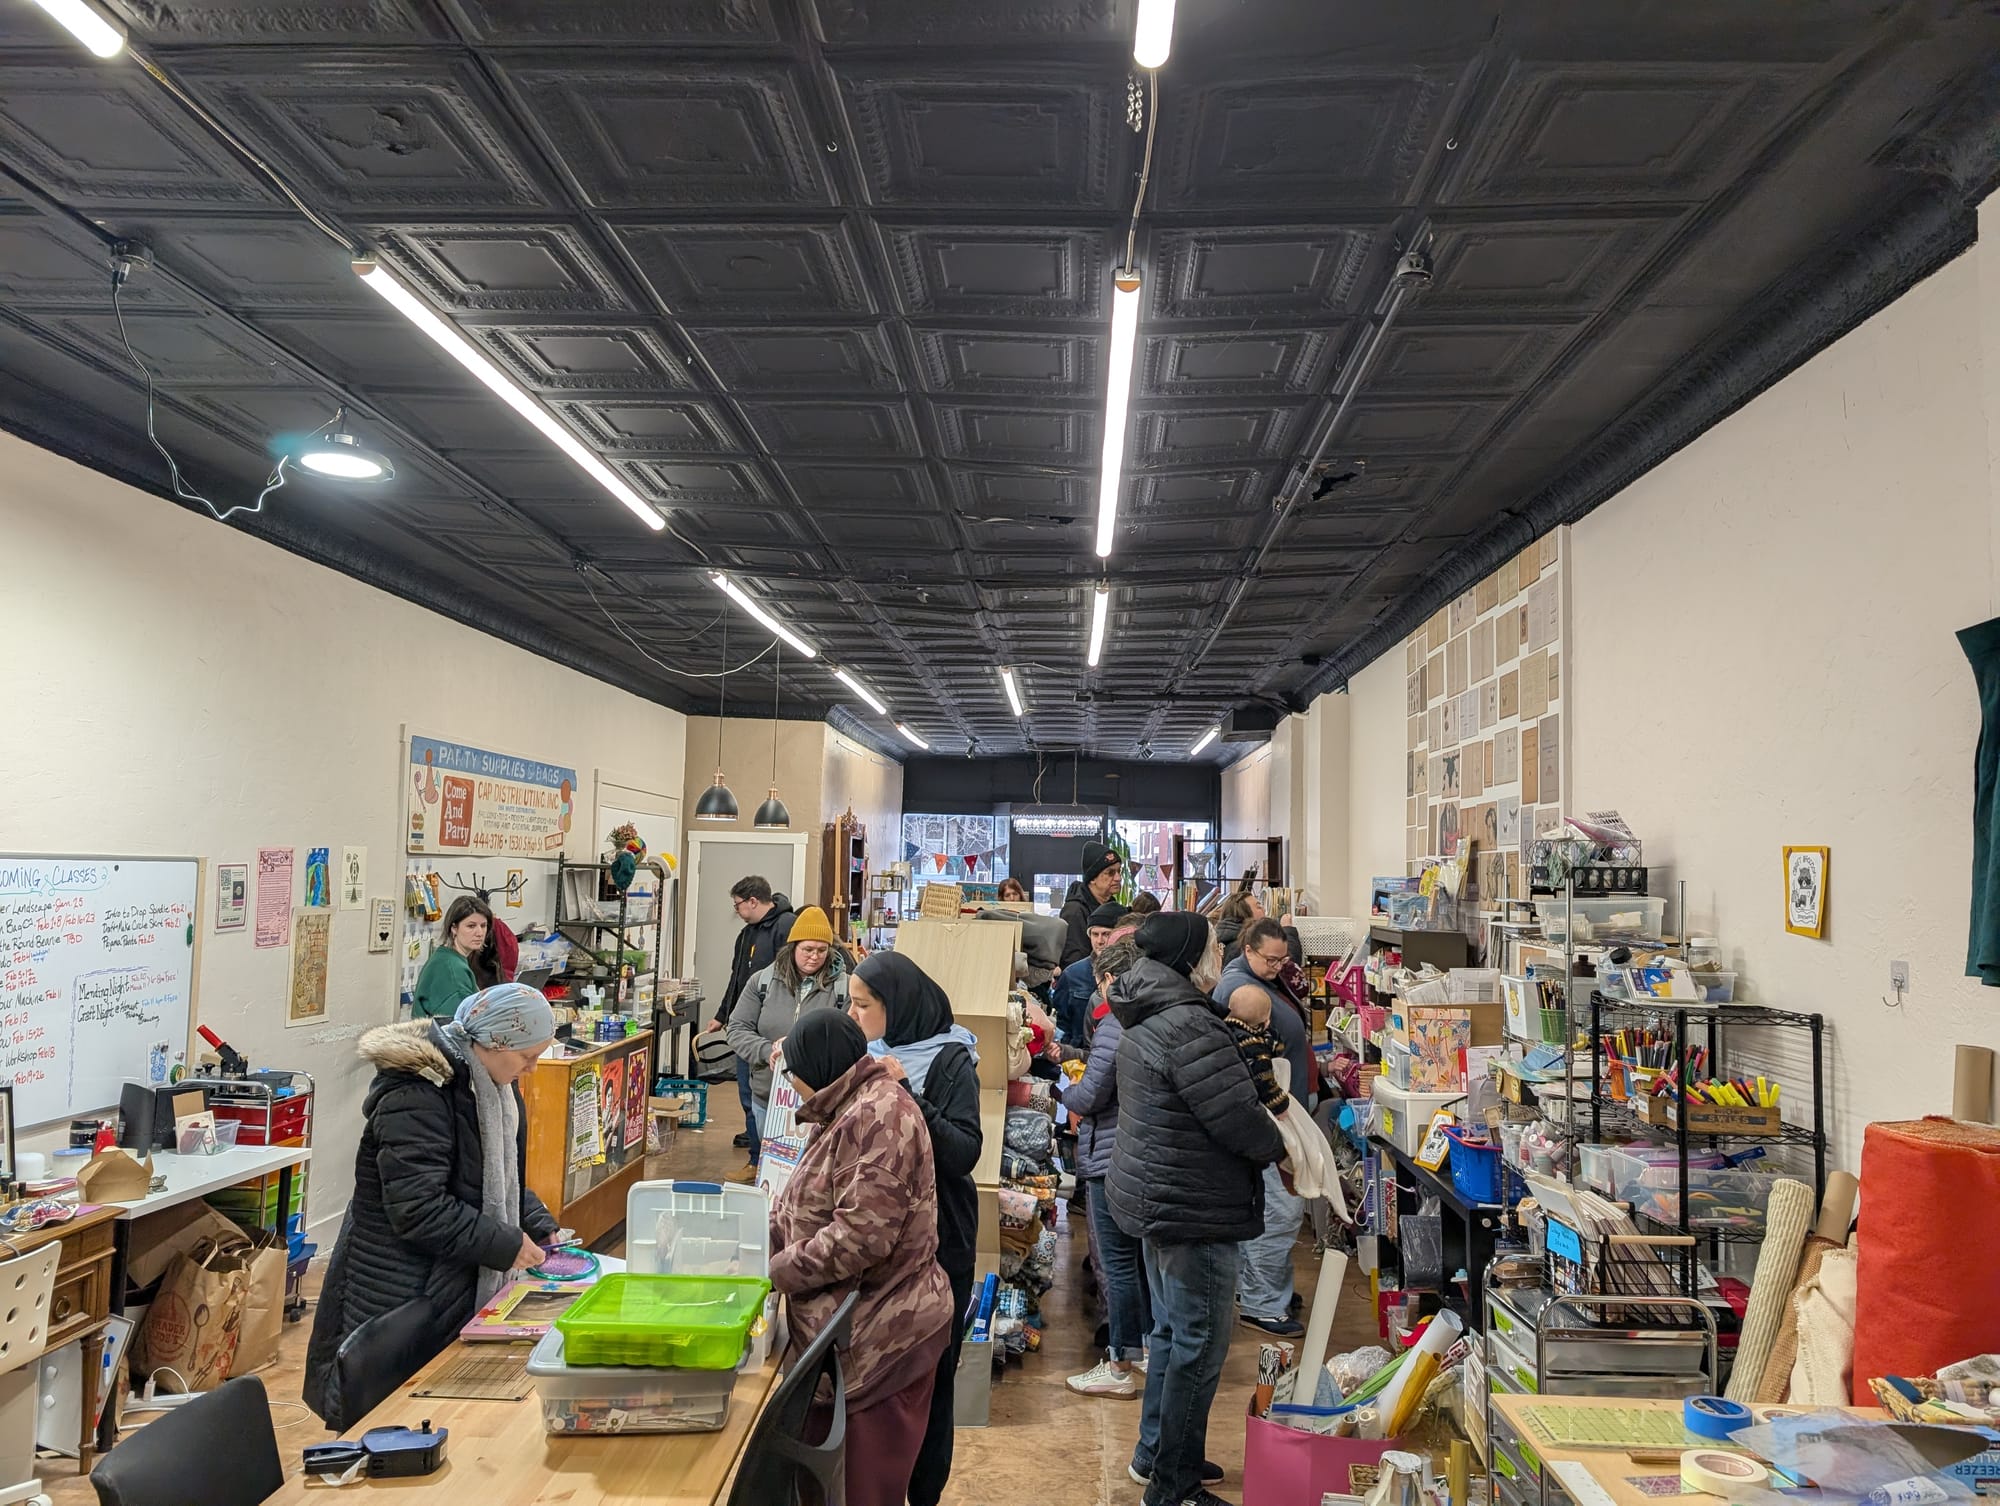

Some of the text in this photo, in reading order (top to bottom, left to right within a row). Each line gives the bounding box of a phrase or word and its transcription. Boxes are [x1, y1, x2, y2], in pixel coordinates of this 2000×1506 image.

[481, 755, 526, 780] SUPPLIES
[536, 765, 560, 785] BAGS
[445, 780, 468, 800] Come
[477, 781, 493, 801] CAP
[444, 800, 463, 820] And
[445, 820, 470, 845] Party
[0, 865, 97, 888] OMING CLASSES
[13, 898, 52, 918] Landscape
[73, 897, 83, 908] 25
[131, 906, 147, 920] Drop
[6, 919, 23, 938] Bag
[63, 932, 83, 944] TBD
[79, 974, 130, 1004] Mending Night
[15, 991, 45, 1009] Machine
[96, 1002, 114, 1027] Night
[6, 1047, 38, 1068] Workshop
[775, 1087, 801, 1109] MUL
[1955, 1465, 2000, 1476] REEZER
